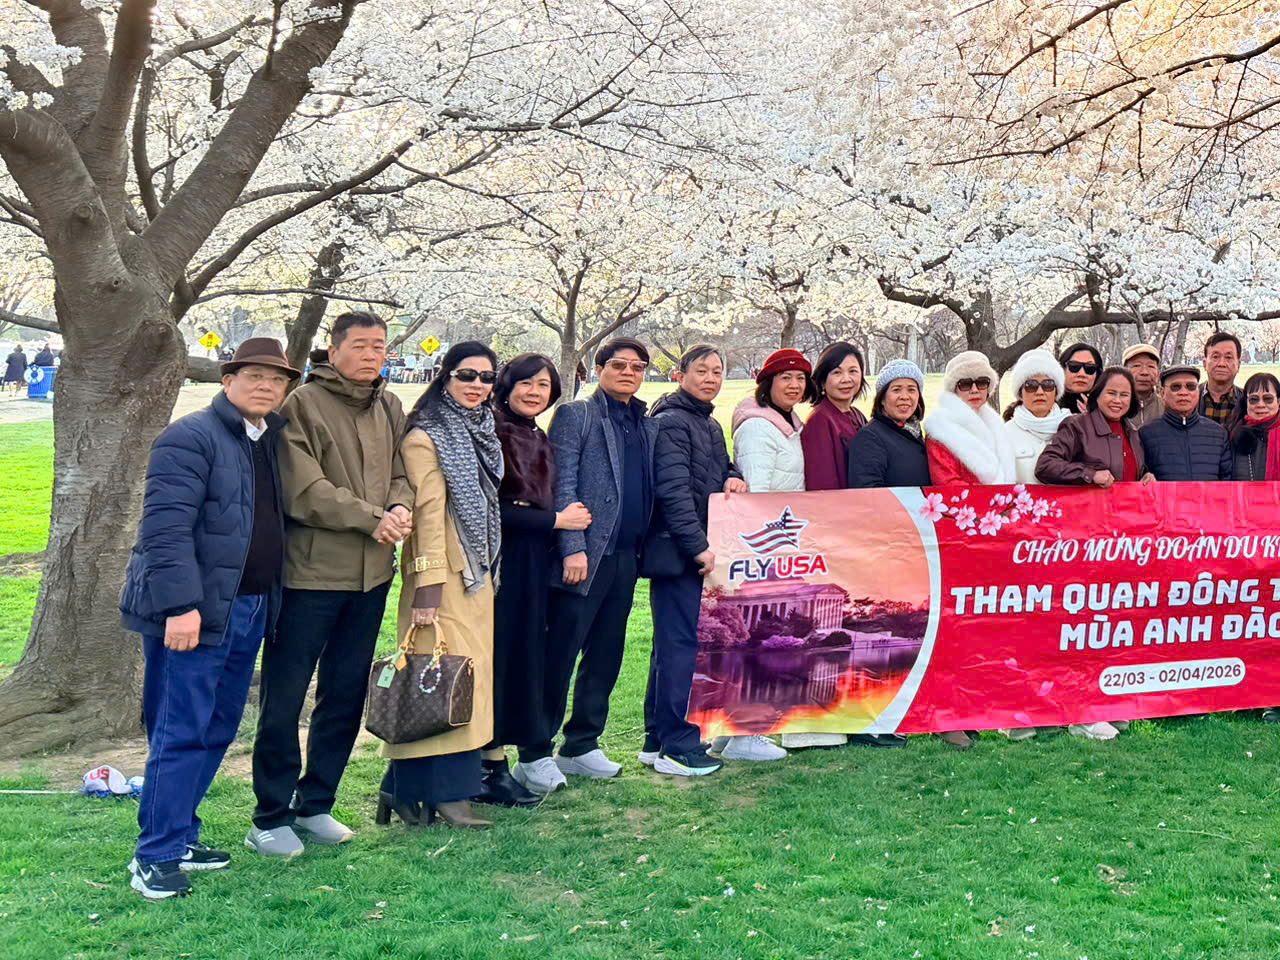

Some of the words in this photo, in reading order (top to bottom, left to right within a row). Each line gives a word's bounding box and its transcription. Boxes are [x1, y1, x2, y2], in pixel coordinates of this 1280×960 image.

[1012, 531, 1079, 565] CHÀO
[1083, 530, 1152, 566] MỪNG
[1155, 529, 1222, 562] ĐOÀN
[1223, 534, 1258, 559] DU
[728, 557, 772, 581] FLY
[775, 553, 829, 578] USA
[950, 584, 1053, 615] THAM
[1062, 581, 1160, 614] QUAN
[1167, 571, 1260, 606] ĐÔNG
[1142, 615, 1213, 645] ANH
[1103, 671, 1145, 688] 22/03
[1158, 664, 1243, 683] 02/04/2026
